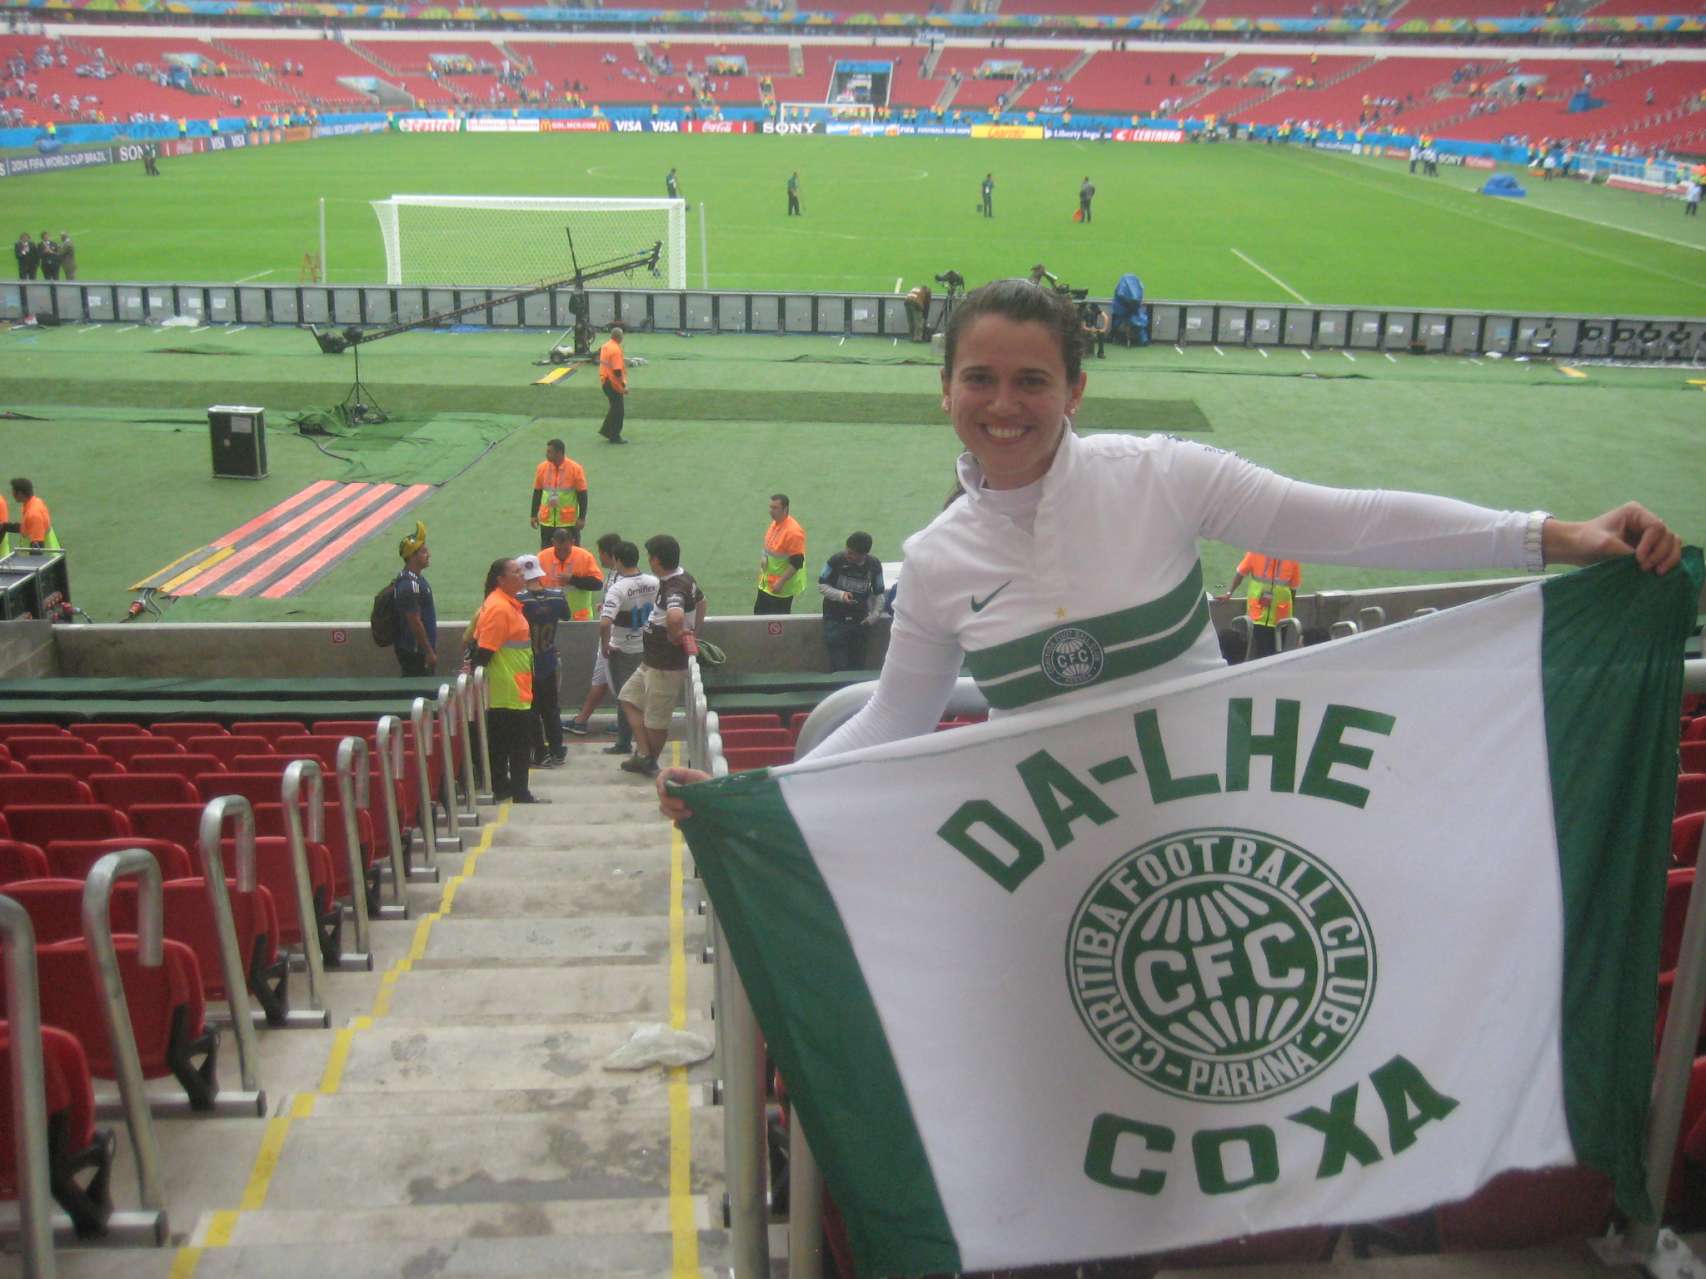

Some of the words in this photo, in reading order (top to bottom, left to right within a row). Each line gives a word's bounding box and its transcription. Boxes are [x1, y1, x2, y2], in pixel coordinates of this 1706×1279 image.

[616, 120, 642, 132] VISA
[651, 120, 678, 132] VISA
[762, 121, 817, 134] SONY
[1057, 649, 1089, 669] CFC
[937, 697, 1397, 894] DA-LHE
[1075, 903, 1165, 1073] CORITIBA
[1313, 916, 1368, 1035] CLUB
[1134, 922, 1305, 1017] CFC
[1083, 1054, 1460, 1196] COXA
